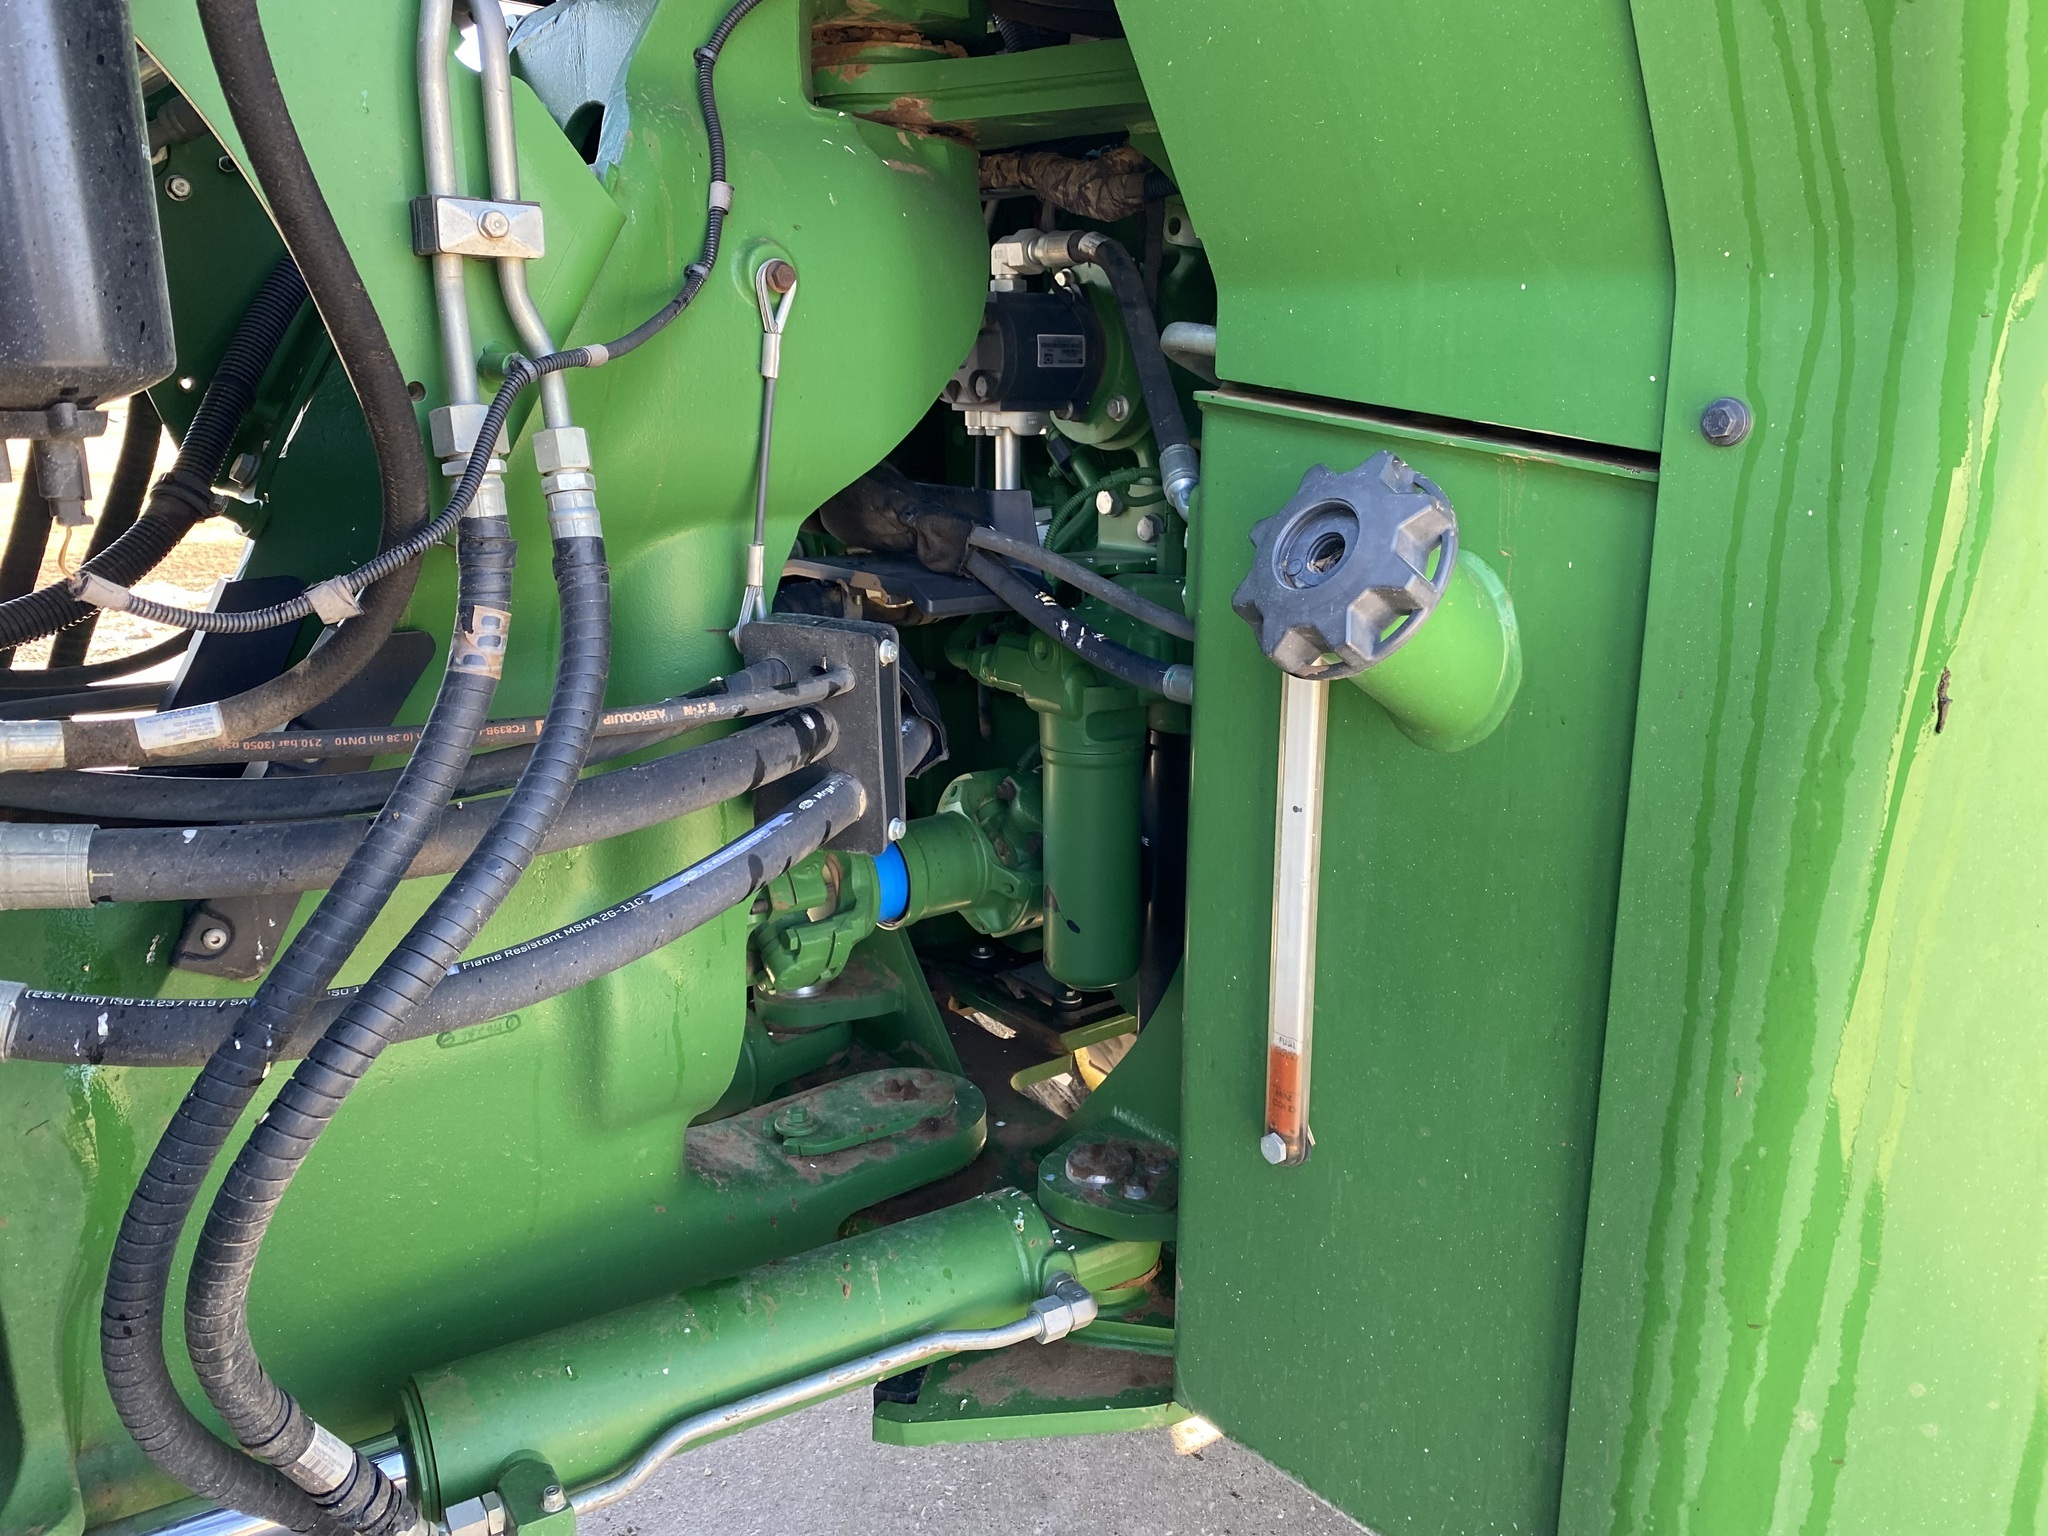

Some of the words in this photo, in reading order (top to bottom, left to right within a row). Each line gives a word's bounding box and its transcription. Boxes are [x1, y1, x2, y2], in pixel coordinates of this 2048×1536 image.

[602, 708, 666, 725] AEROQUIP
[301, 738, 322, 747] 210
[335, 736, 366, 746] DN10
[369, 734, 384, 744] in)
[387, 732, 413, 743] (0.38
[243, 741, 276, 751] (3050
[278, 739, 297, 748] bar
[109, 997, 134, 1006] ISO
[188, 1000, 216, 1008] R19
[462, 953, 503, 970] Flame
[504, 931, 564, 958] Resistant
[563, 917, 600, 937] MSHA
[599, 897, 645, 922] 2G-11C
